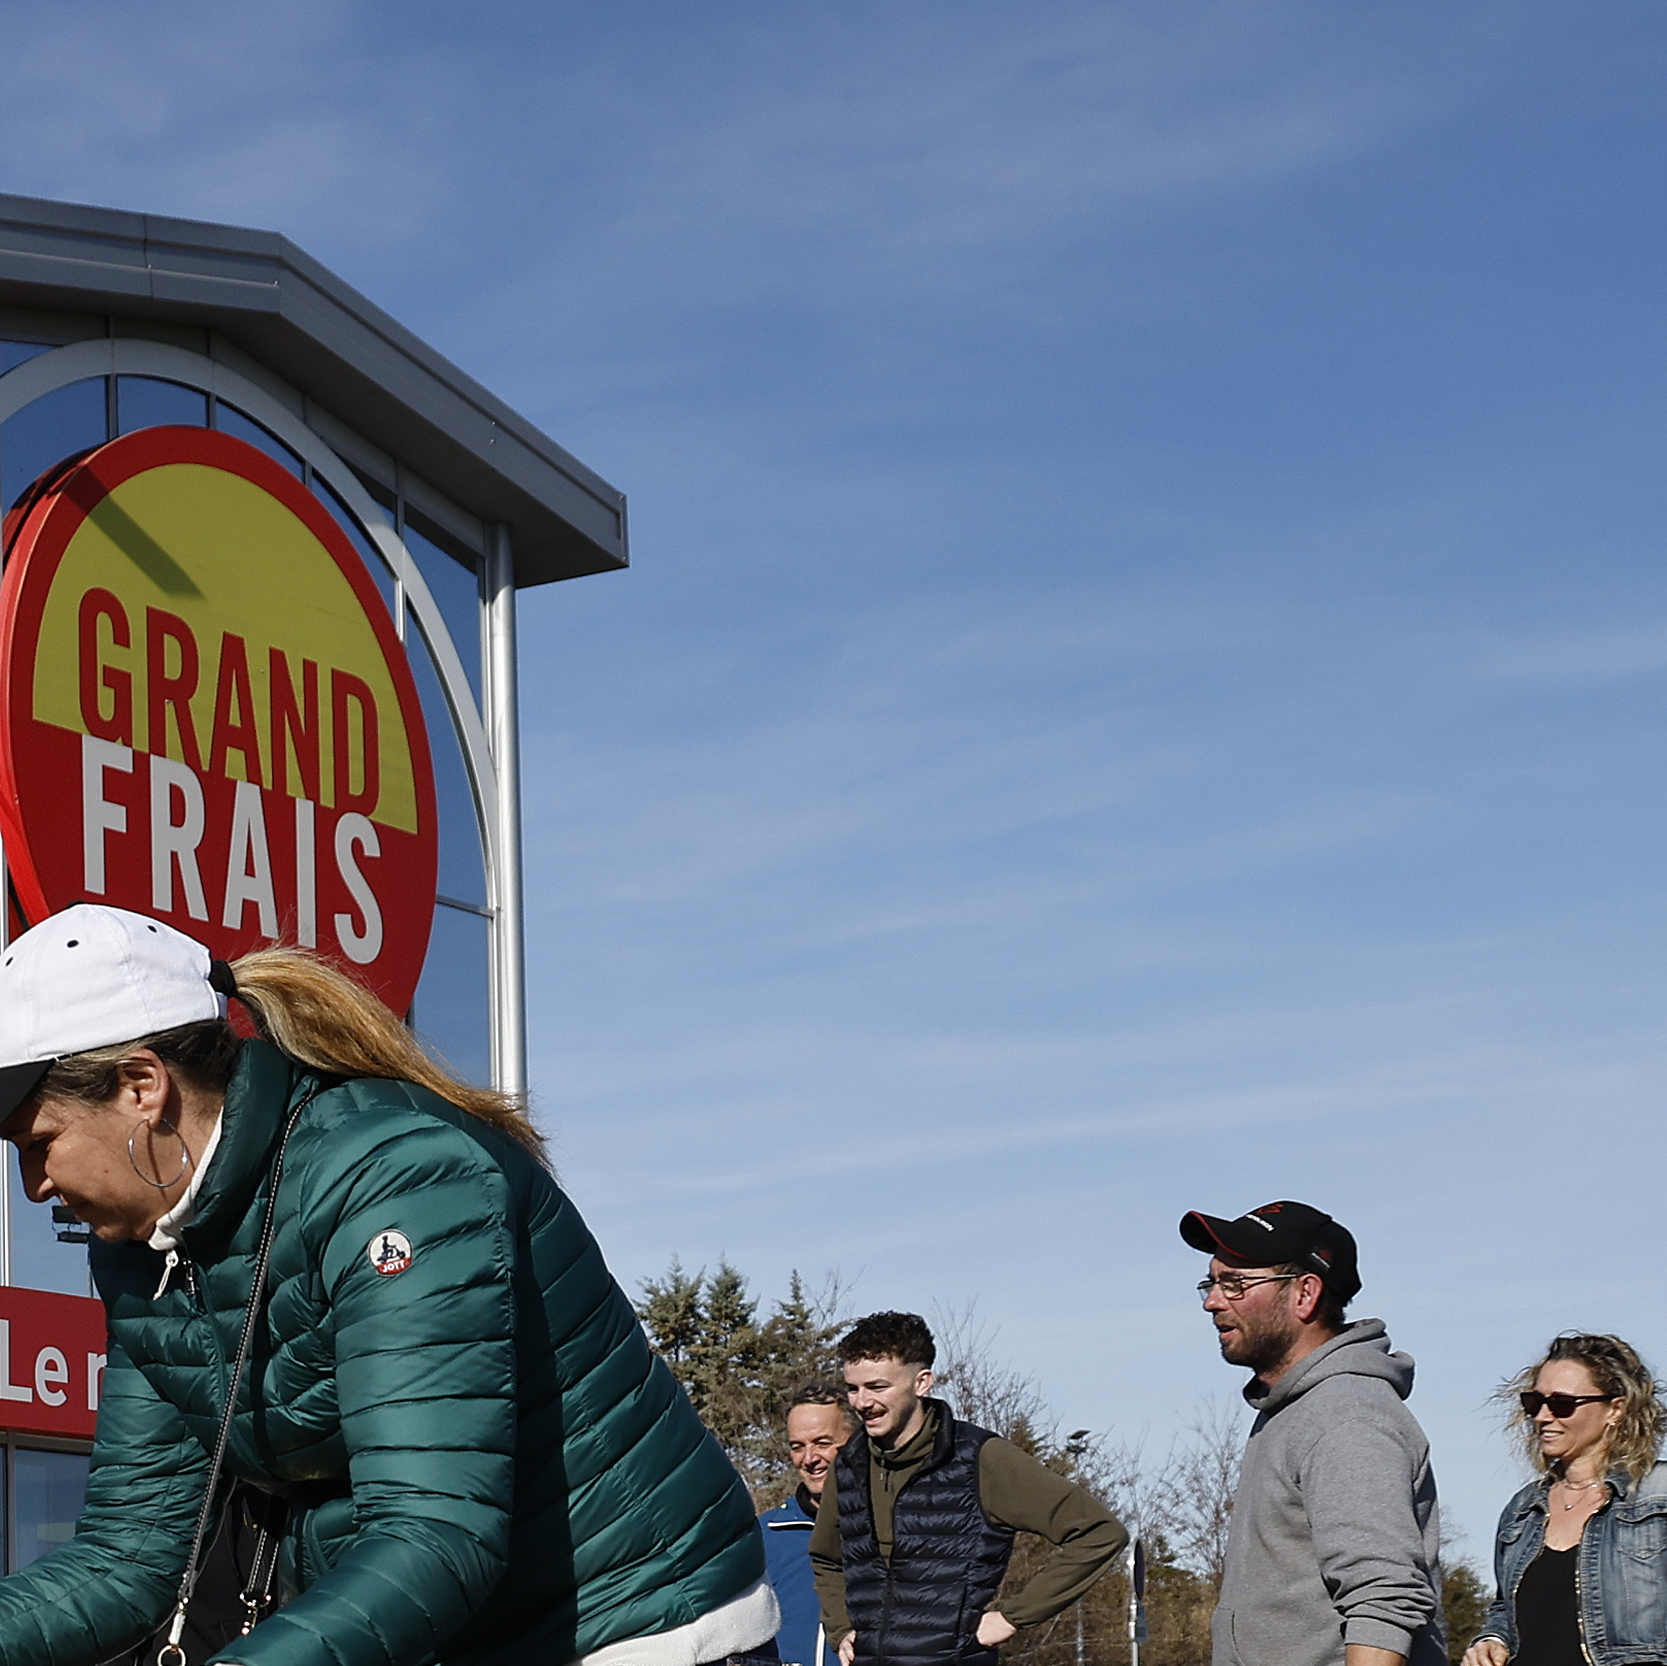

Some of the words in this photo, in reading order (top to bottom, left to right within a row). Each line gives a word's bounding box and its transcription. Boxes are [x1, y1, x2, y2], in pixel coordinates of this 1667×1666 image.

[78, 586, 380, 816] GRAND
[82, 733, 383, 964] FRAIS
[382, 1260, 405, 1273] JOTT
